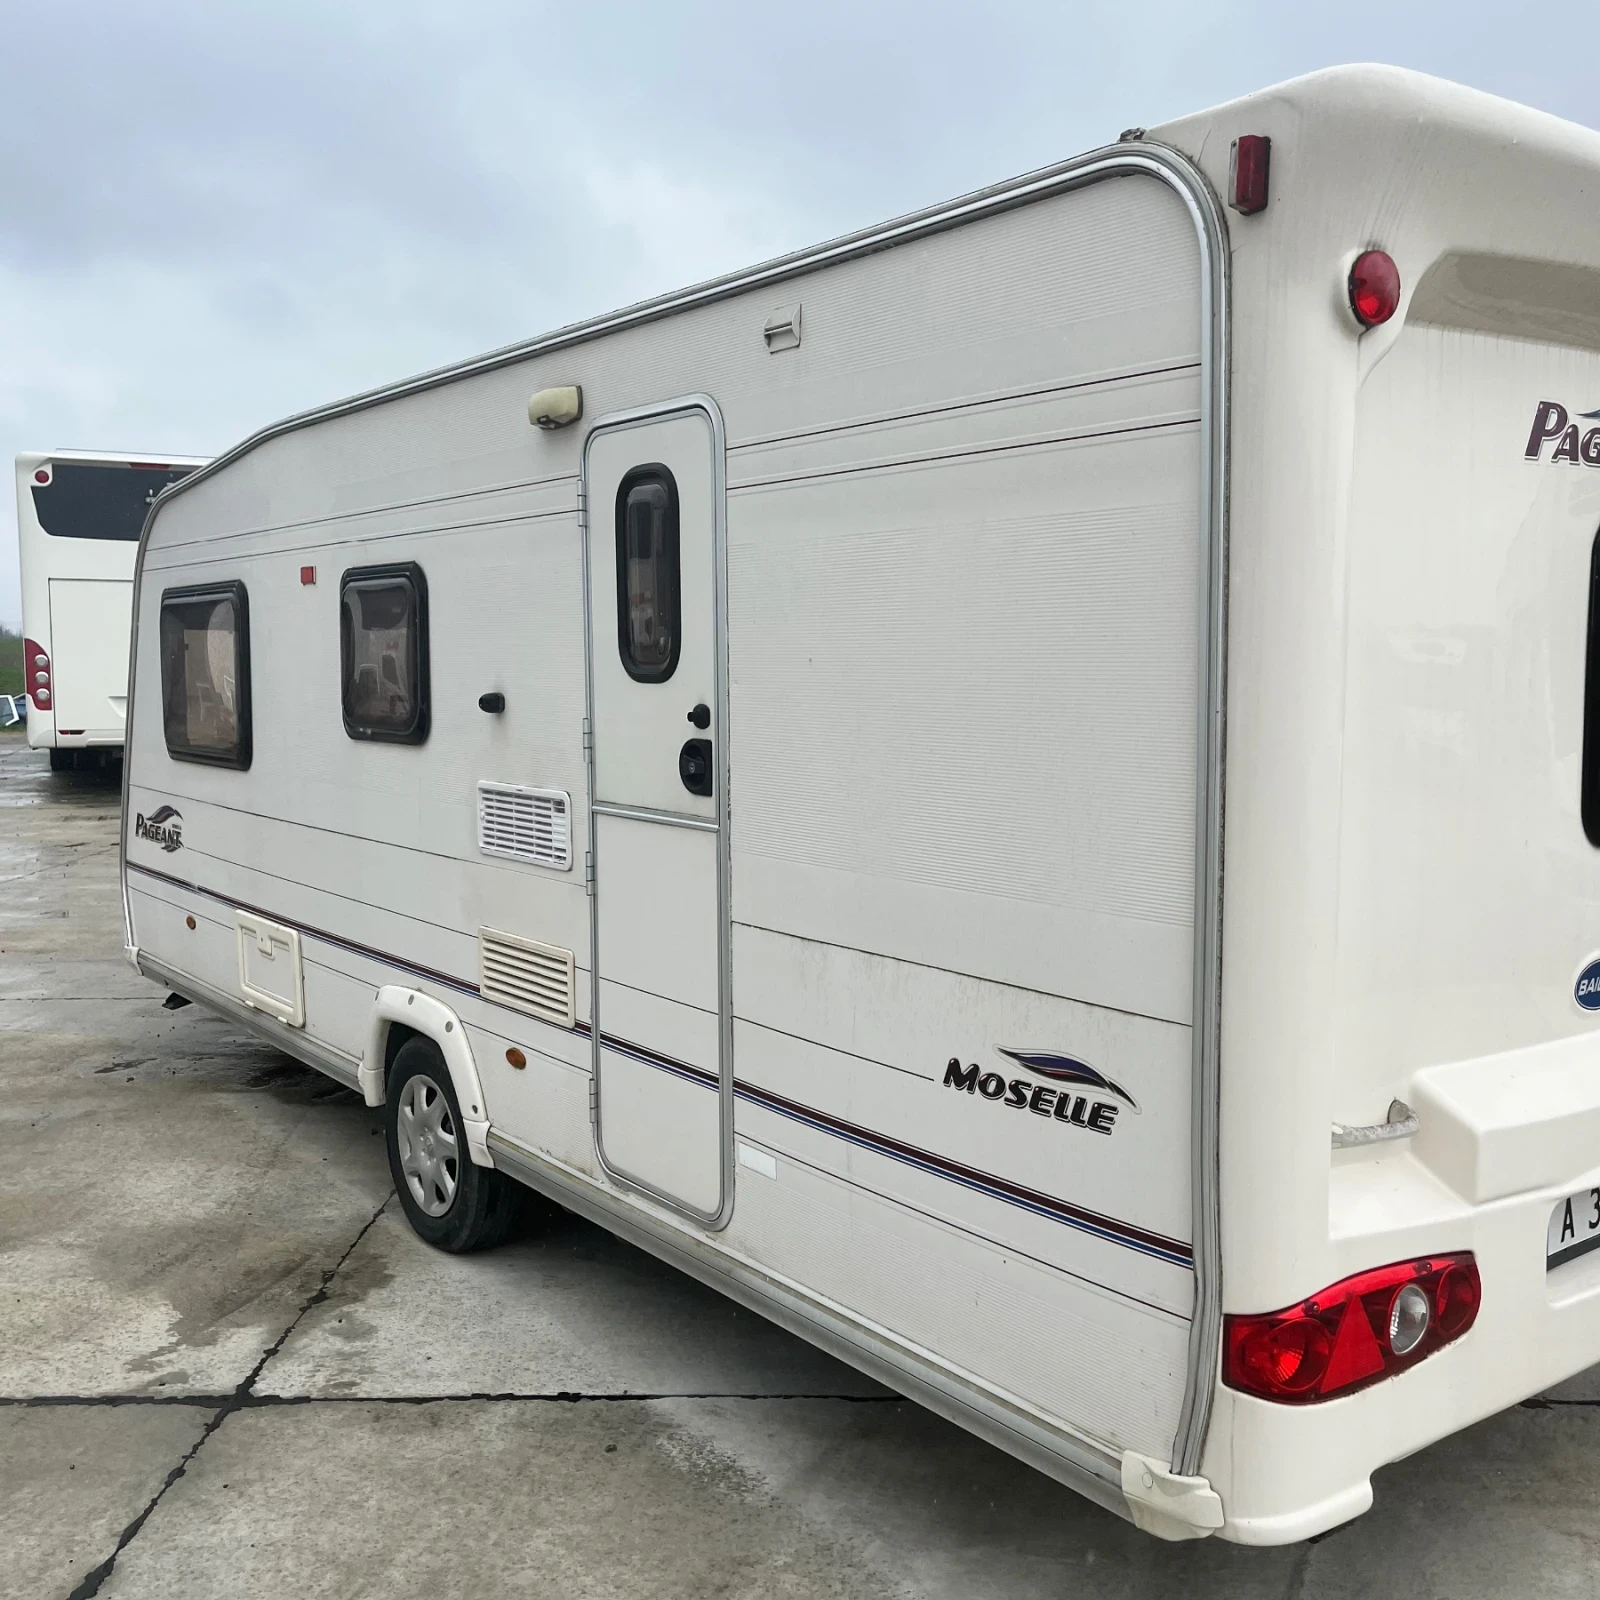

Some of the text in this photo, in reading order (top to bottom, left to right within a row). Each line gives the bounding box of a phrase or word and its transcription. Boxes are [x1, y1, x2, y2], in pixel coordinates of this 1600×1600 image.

[1523, 400, 1600, 468] PAG
[135, 812, 182, 847] PAGEANT
[942, 1057, 1119, 1136] MOSELLE
[1560, 1187, 1600, 1243] A 3
